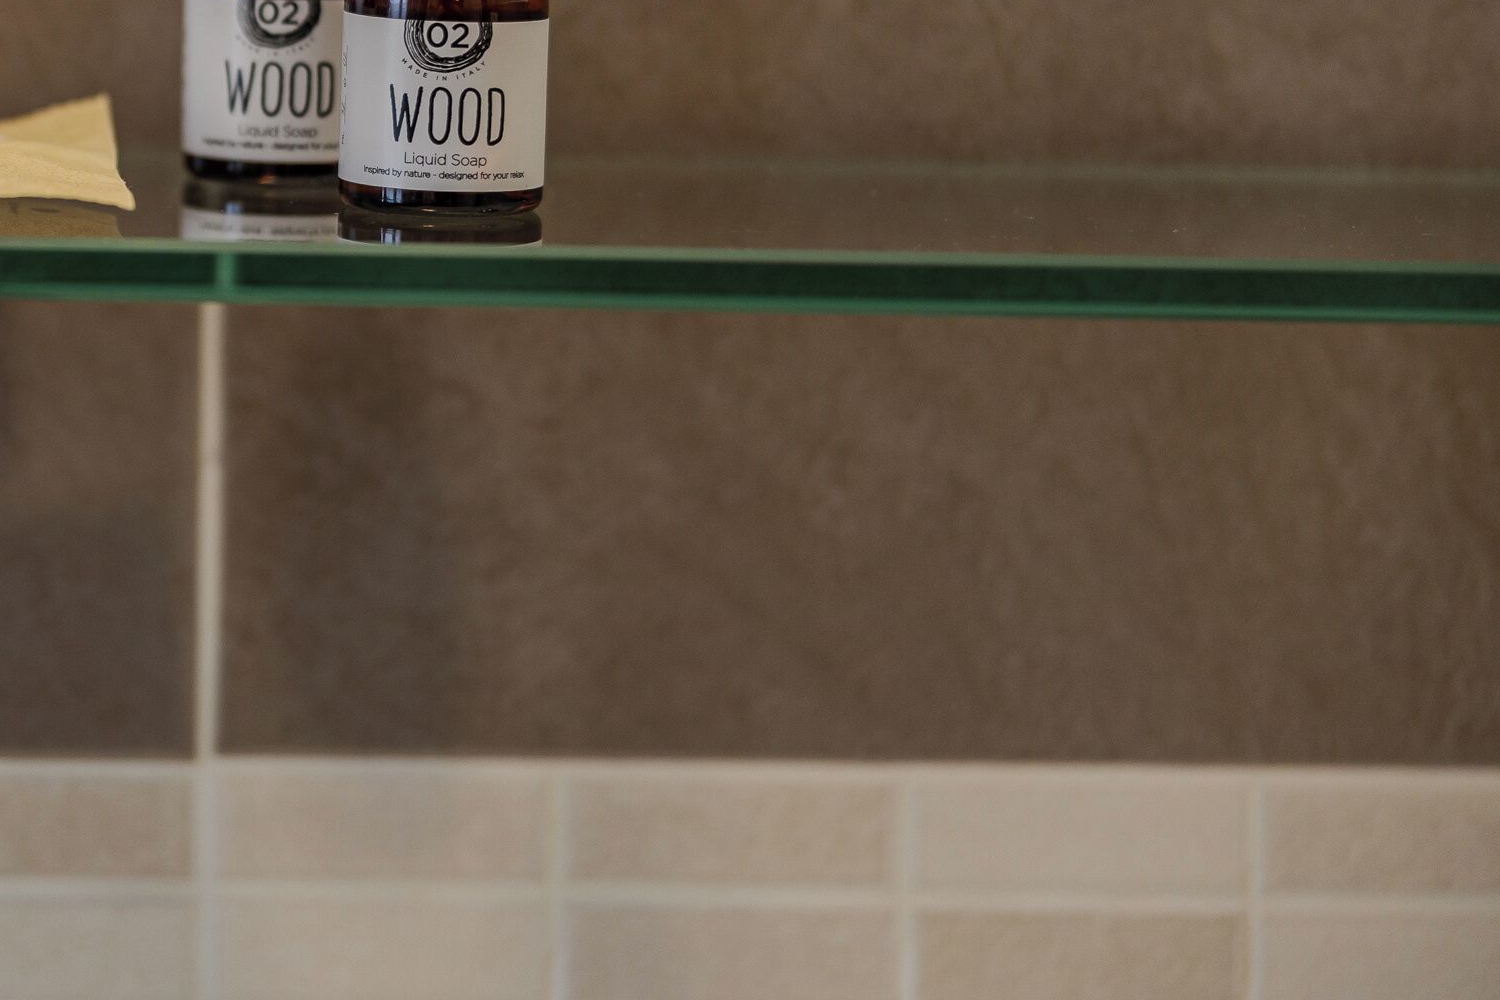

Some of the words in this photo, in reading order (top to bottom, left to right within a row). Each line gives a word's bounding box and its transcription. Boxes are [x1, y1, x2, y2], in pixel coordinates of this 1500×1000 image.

[258, 1, 300, 25] 02
[426, 23, 470, 49] 02
[401, 58, 428, 79] MADE
[456, 61, 486, 80] ITALY
[224, 59, 335, 119] WOOD
[389, 83, 506, 146] WOOD
[283, 124, 319, 139] Soap
[404, 151, 447, 167] Liquid
[451, 153, 488, 168] Soap
[363, 165, 391, 175] Inspired
[392, 168, 402, 177] by
[403, 170, 431, 179] nature
[438, 171, 479, 181] designed
[480, 172, 492, 180] for
[493, 173, 509, 181] your
